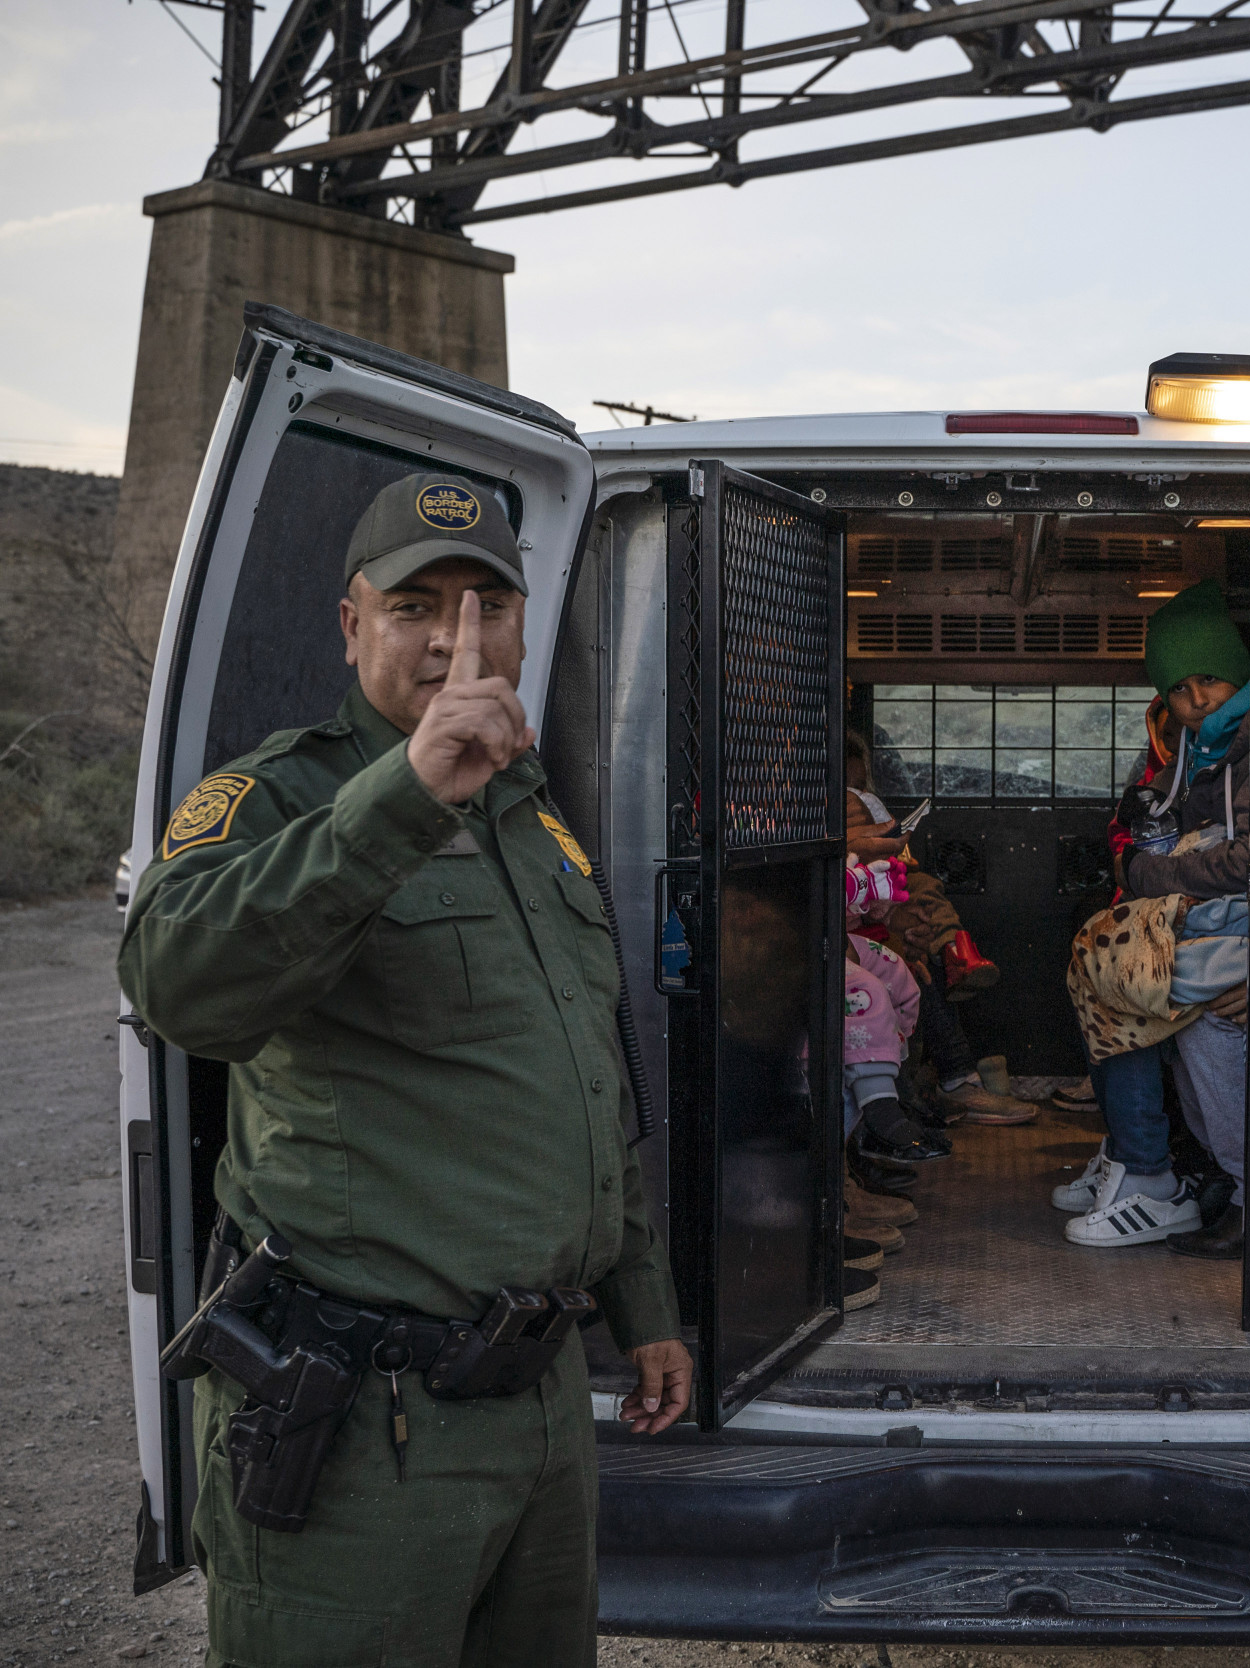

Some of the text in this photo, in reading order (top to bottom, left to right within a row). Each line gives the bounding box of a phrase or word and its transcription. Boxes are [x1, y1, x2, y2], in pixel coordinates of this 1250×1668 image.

[439, 490, 459, 499] U.S.
[425, 499, 473, 509] BORDER
[426, 508, 473, 519] PATROL
